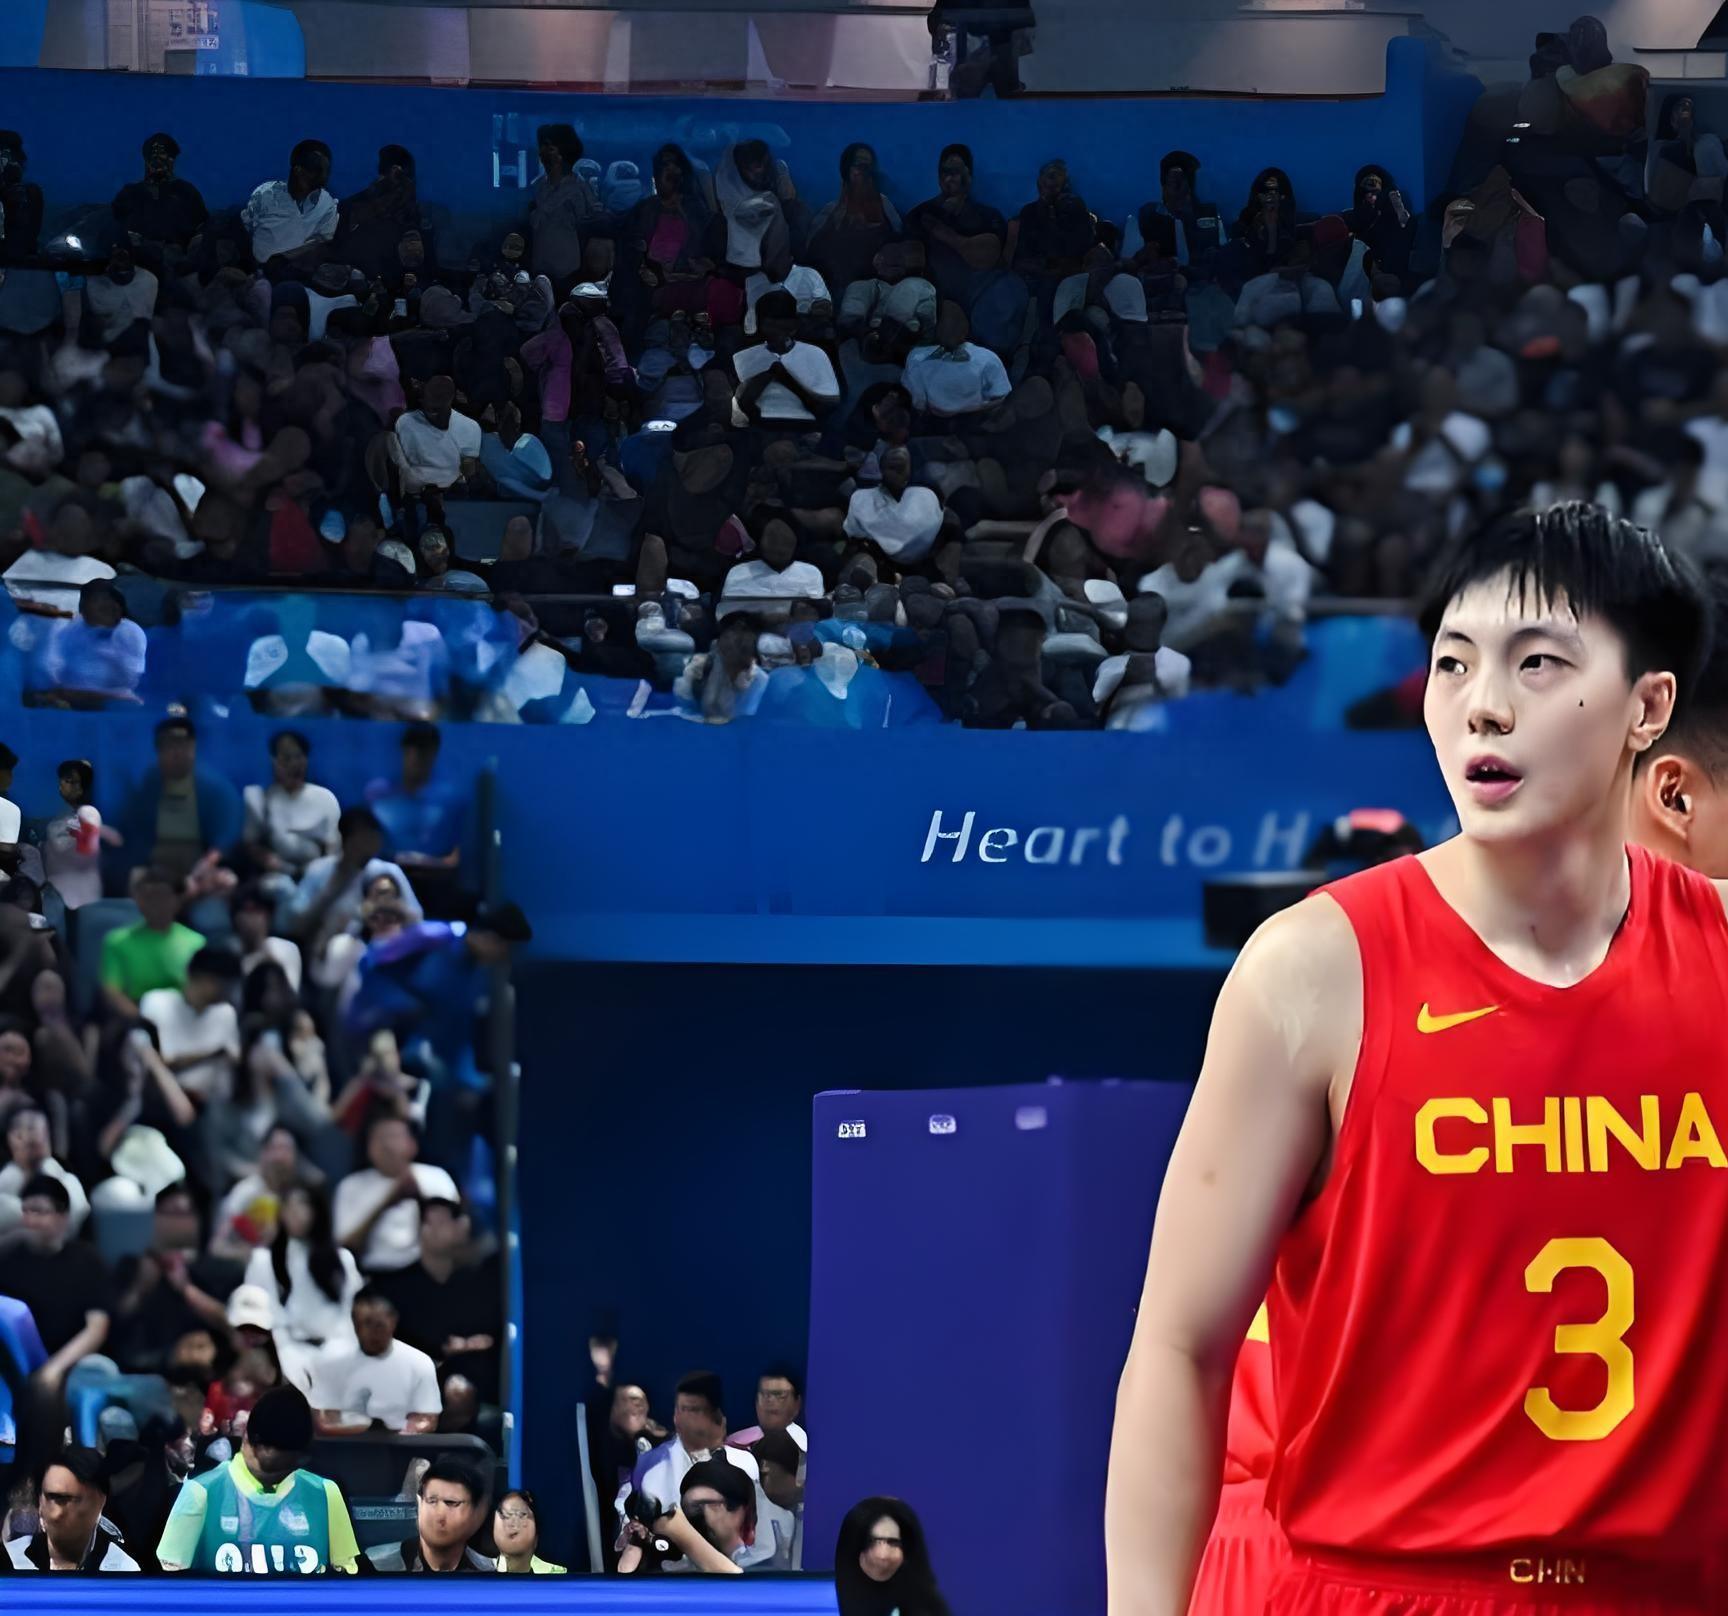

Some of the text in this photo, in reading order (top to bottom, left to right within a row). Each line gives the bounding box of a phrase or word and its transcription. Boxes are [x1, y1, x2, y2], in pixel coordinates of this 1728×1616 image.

[921, 809, 1129, 866] Heart
[1160, 814, 1231, 867] to
[1523, 1236, 1635, 1441] 3
[1509, 1557, 1585, 1584] CHN
